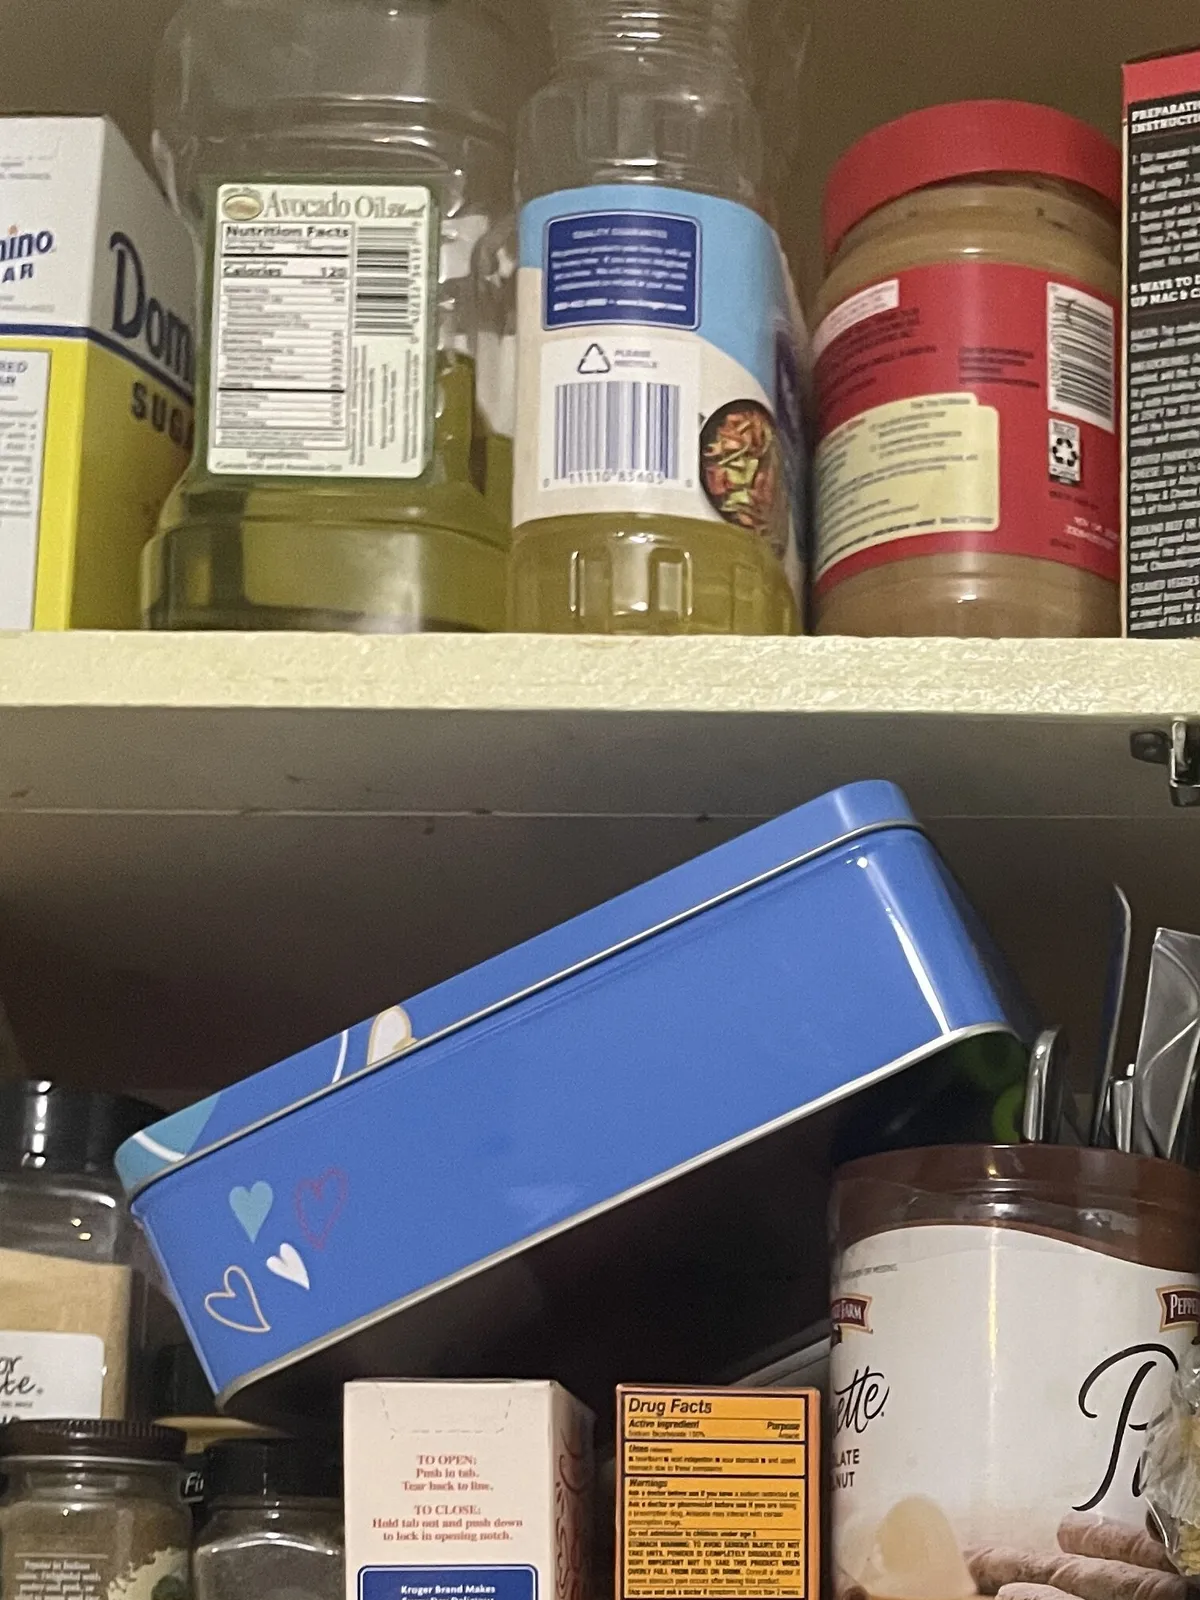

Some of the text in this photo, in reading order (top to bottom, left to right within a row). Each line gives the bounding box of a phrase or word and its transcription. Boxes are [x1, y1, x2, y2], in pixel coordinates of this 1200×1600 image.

[265, 191, 352, 216] Avocado
[629, 1399, 711, 1415] Drug Facts
[401, 1584, 495, 1597] Kroger Brand Makes
